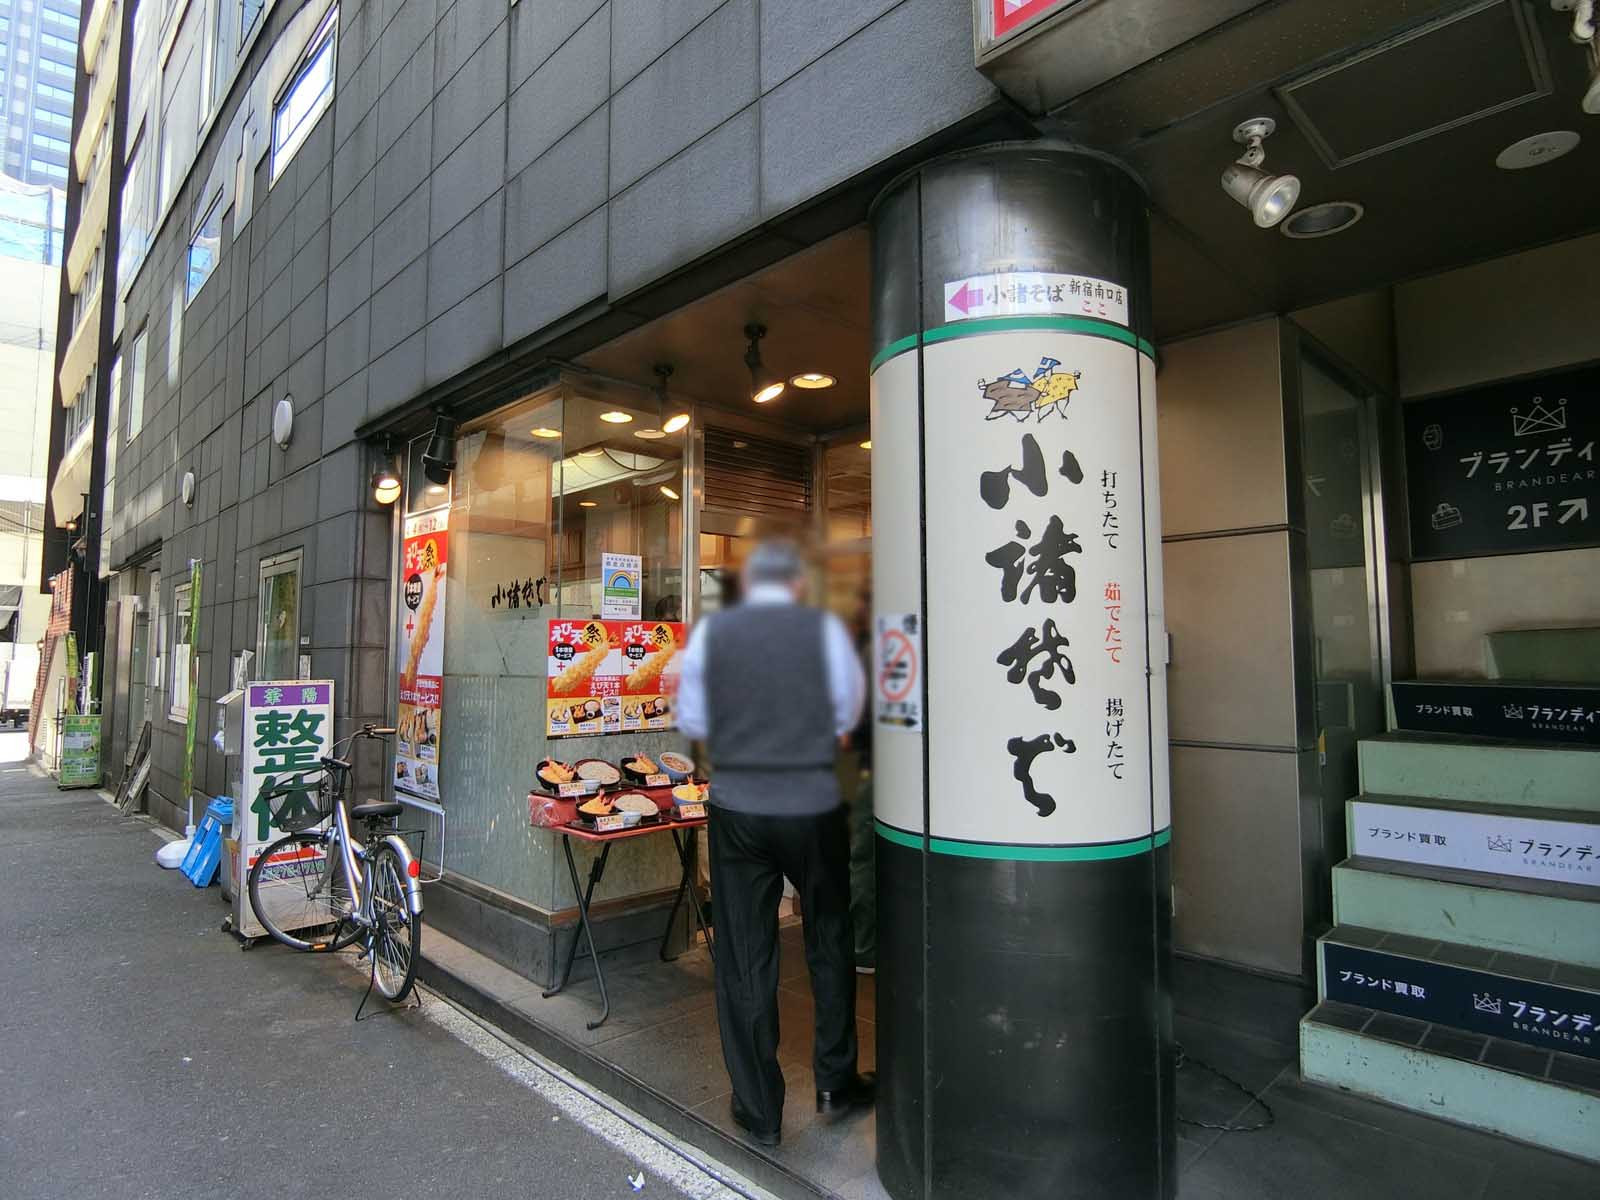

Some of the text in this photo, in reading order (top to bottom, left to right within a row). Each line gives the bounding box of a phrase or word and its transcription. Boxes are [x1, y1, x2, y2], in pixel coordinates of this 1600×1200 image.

[986, 278, 1123, 305] 小諸そば 新宿南口店
[1081, 300, 1106, 317] ここ
[1459, 437, 1595, 478] ブランディ
[1495, 470, 1595, 492] BRANDEAR
[1100, 469, 1119, 550] 打ちたて
[1507, 502, 1549, 530] 2F
[1104, 582, 1123, 664] 茹でたて
[1416, 704, 1473, 717] ブランド買取
[1106, 698, 1125, 781] 揚げたて
[250, 709, 326, 841] 整体
[1368, 827, 1447, 846] ブランド買取
[1339, 970, 1426, 999] ブランド買取
[1512, 1021, 1591, 1045] BRANDEAR
